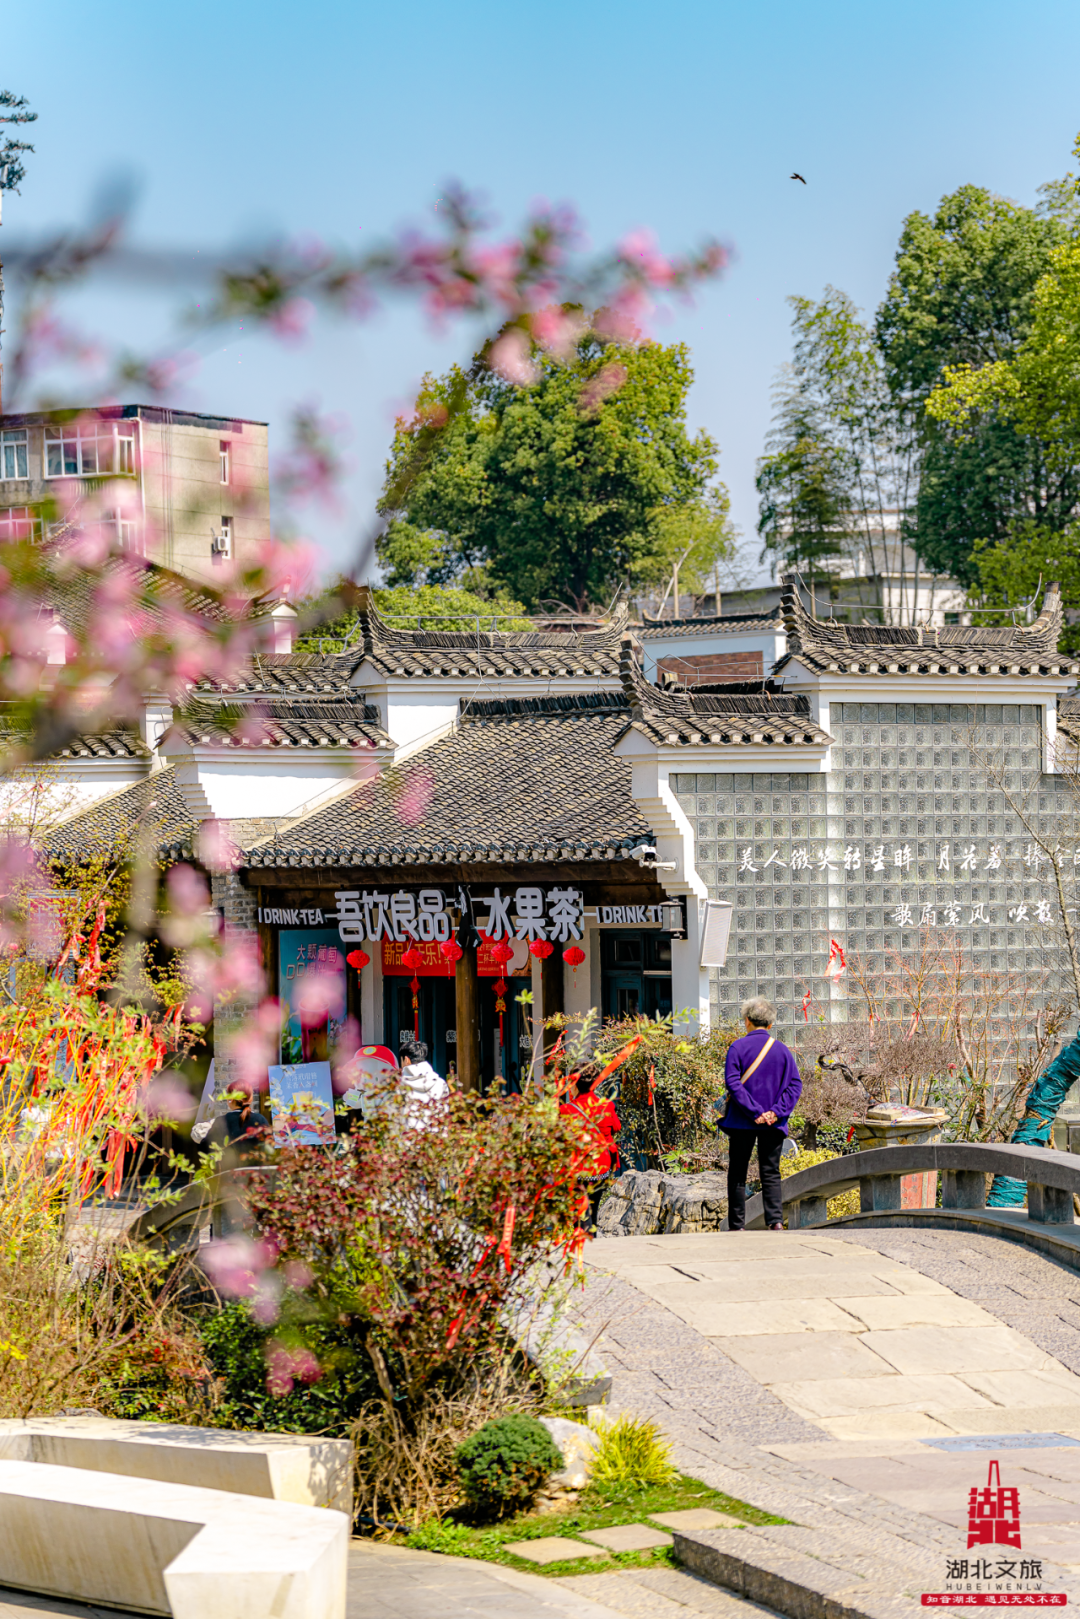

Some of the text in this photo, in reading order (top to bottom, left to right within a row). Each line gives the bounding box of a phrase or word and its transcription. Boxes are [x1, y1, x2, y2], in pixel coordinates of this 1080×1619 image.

[258, 907, 324, 926] I DRINK TEA
[335, 886, 583, 942] 吾饮良品 水果茶
[595, 905, 663, 924] I DRINK TE
